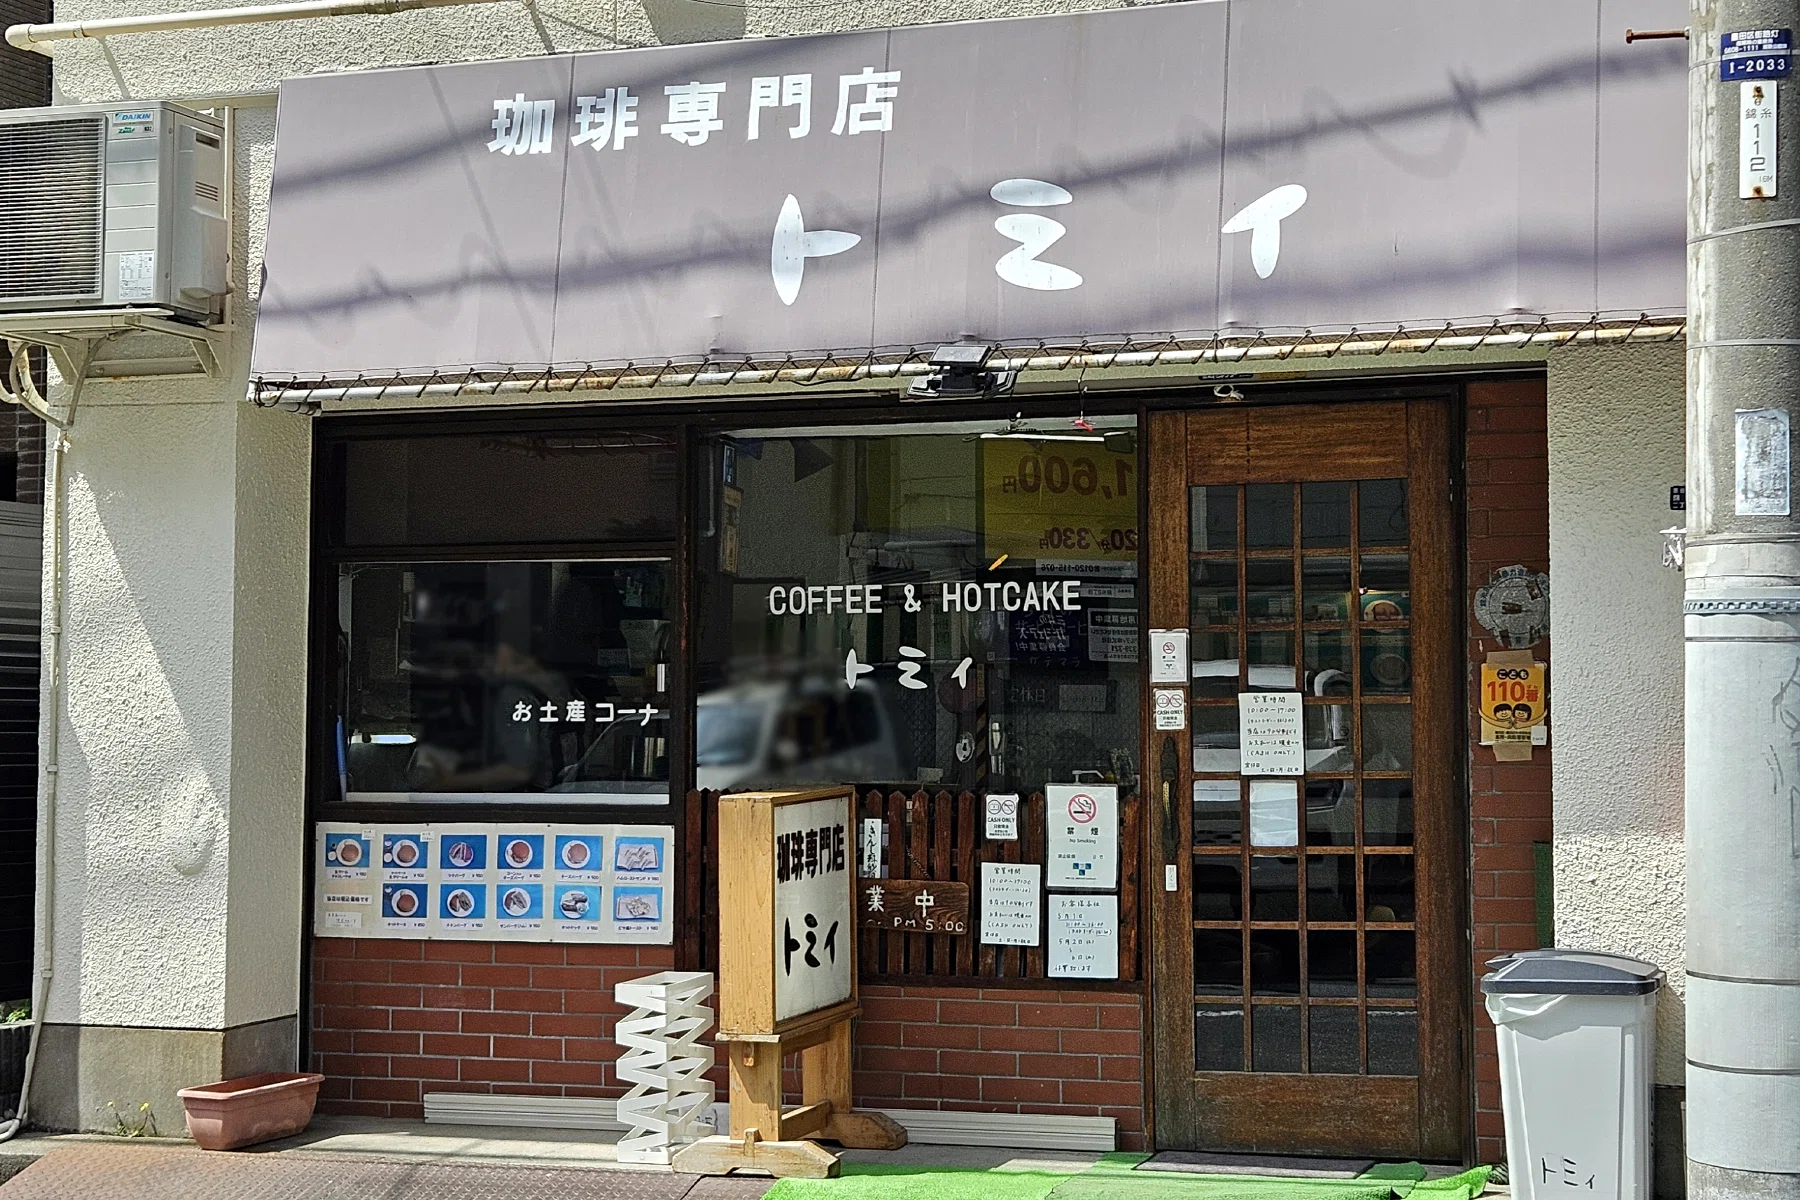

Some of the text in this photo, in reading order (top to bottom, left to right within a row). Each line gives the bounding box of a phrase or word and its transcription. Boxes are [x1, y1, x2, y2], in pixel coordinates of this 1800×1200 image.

[487, 67, 901, 156] 珈琲専門店
[768, 585, 883, 615] COFFEE
[904, 584, 921, 611] &
[942, 581, 1081, 612] HOTCAKE
[1498, 669, 1528, 679] こども
[1487, 681, 1539, 702] 110番
[777, 823, 844, 884] 珈琲専門店
